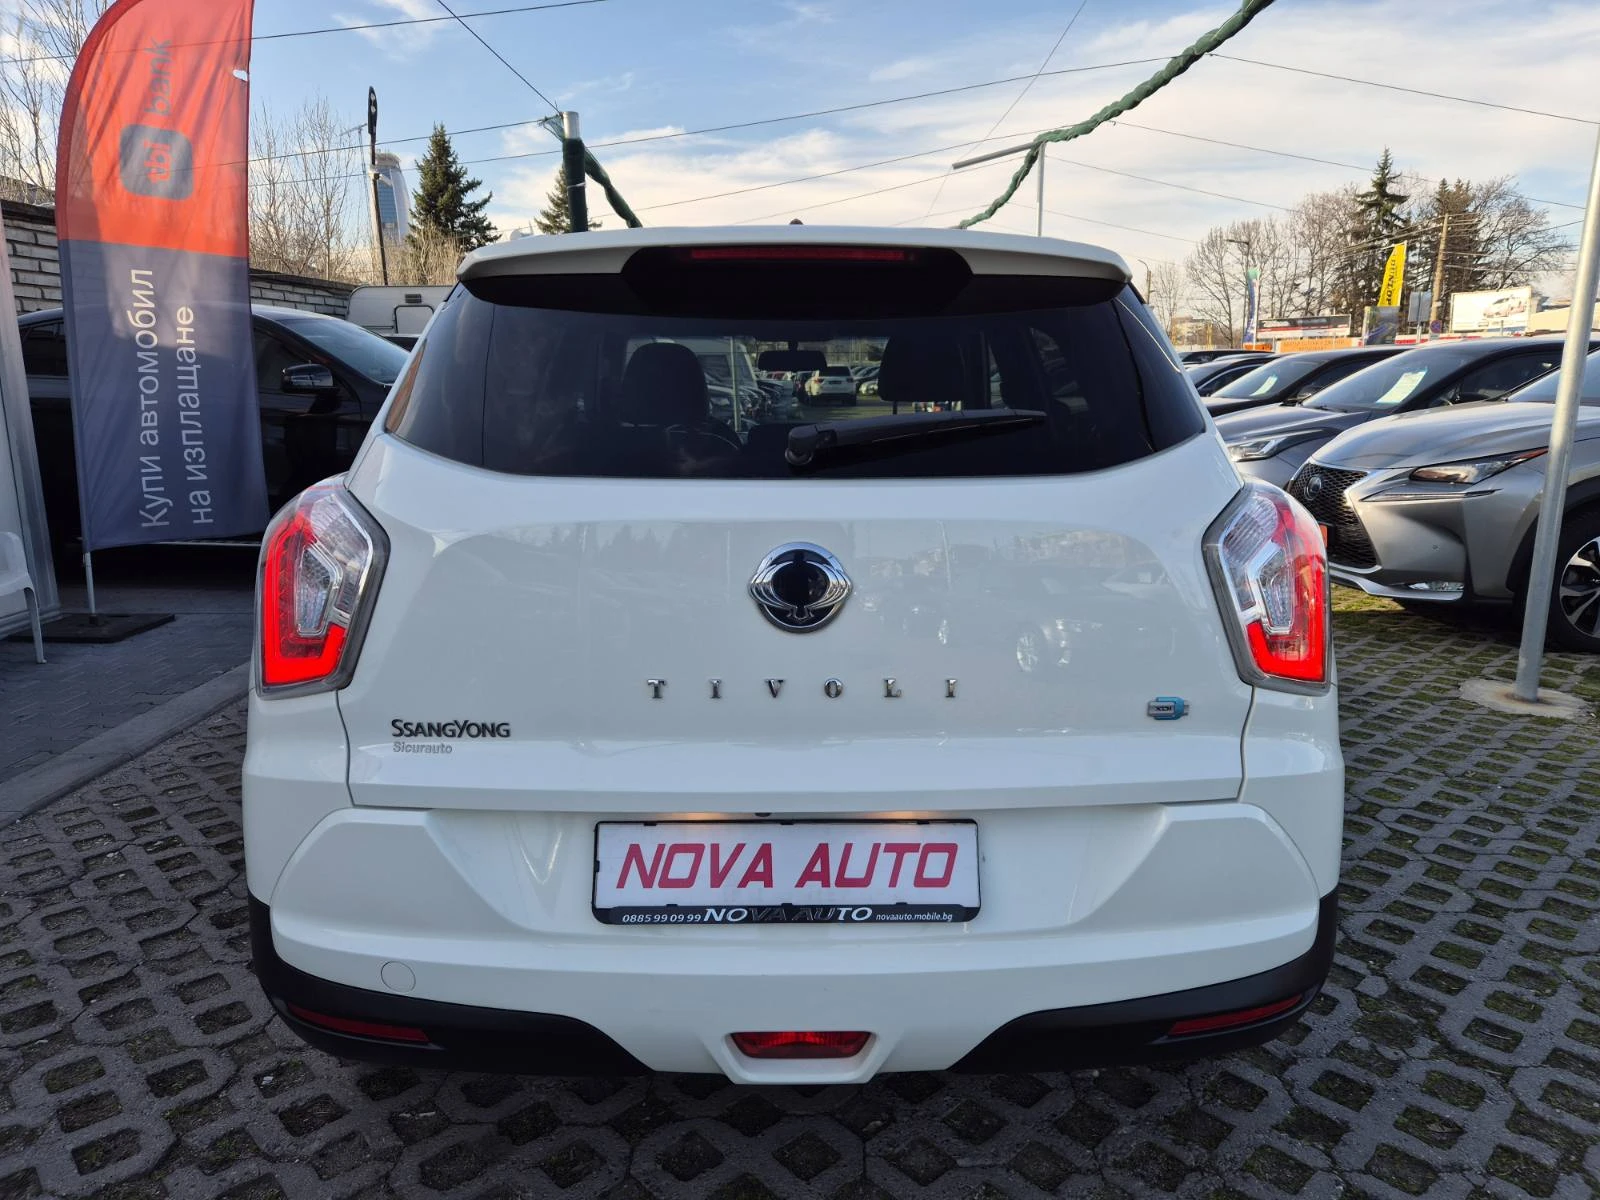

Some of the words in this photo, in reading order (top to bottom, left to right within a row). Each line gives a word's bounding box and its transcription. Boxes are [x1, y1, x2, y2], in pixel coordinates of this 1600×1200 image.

[144, 37, 173, 116] bank
[144, 140, 172, 184] tbi
[127, 269, 160, 446] автомобил
[176, 306, 208, 481] изплащане
[139, 456, 174, 527] Купи
[189, 490, 214, 524] на
[647, 678, 958, 699] TIVOLI
[616, 843, 774, 889] NOVA
[794, 842, 959, 888] AUTO
[622, 914, 651, 923] 0885
[654, 914, 668, 923] 99
[669, 914, 685, 923] 09
[686, 913, 701, 922] 99
[703, 908, 788, 922] NOVA
[791, 907, 873, 921] AUTO
[875, 911, 953, 923] novaauto.mobile.bg
